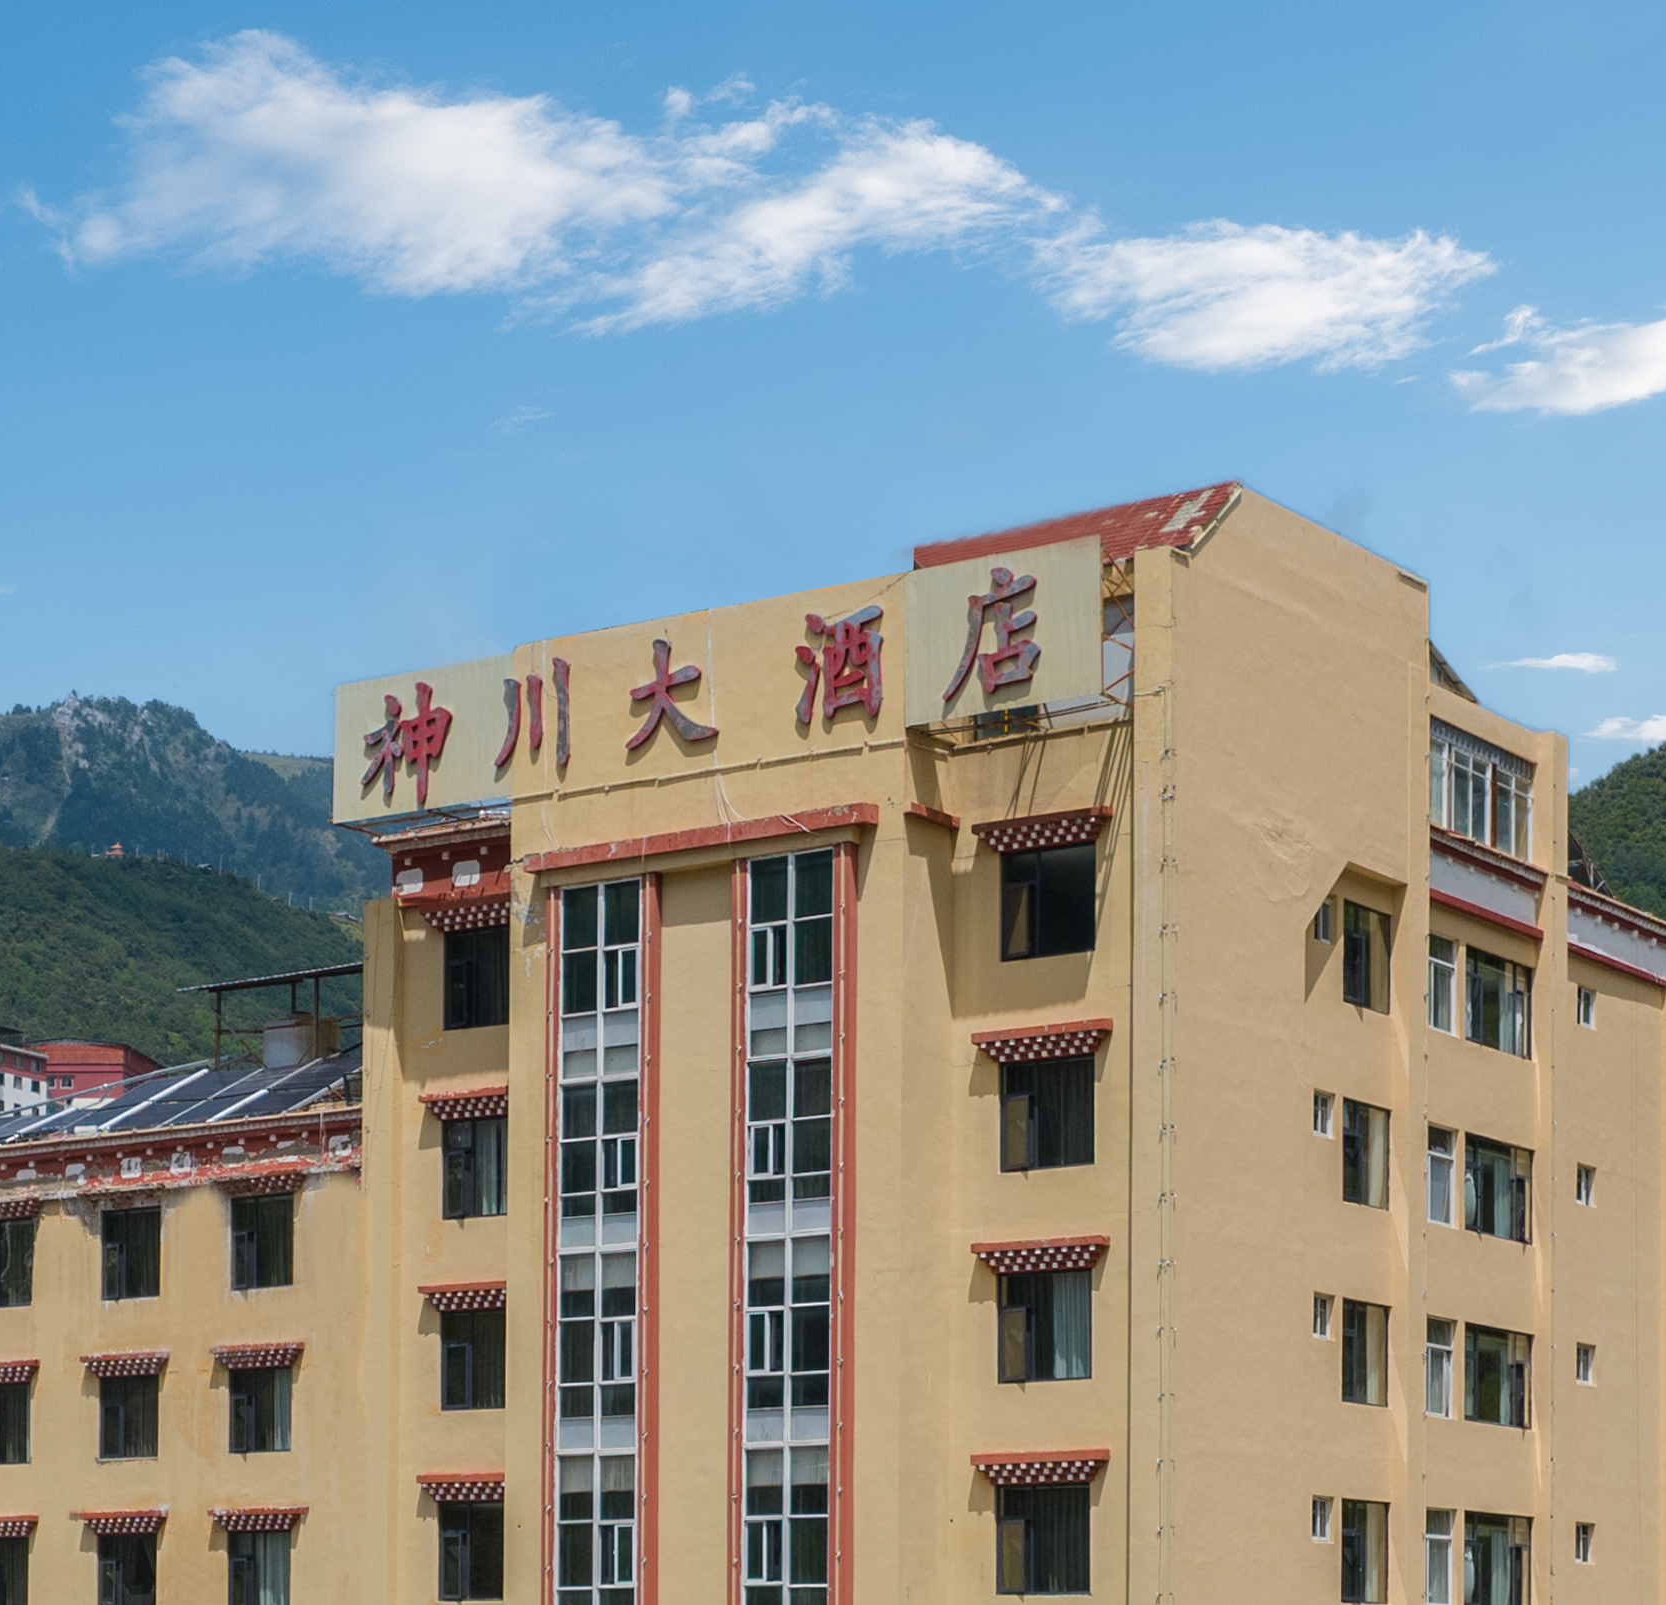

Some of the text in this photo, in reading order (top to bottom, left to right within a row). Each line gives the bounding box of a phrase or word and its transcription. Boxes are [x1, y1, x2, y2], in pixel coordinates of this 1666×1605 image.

[360, 566, 1042, 804] 神川大酒店
